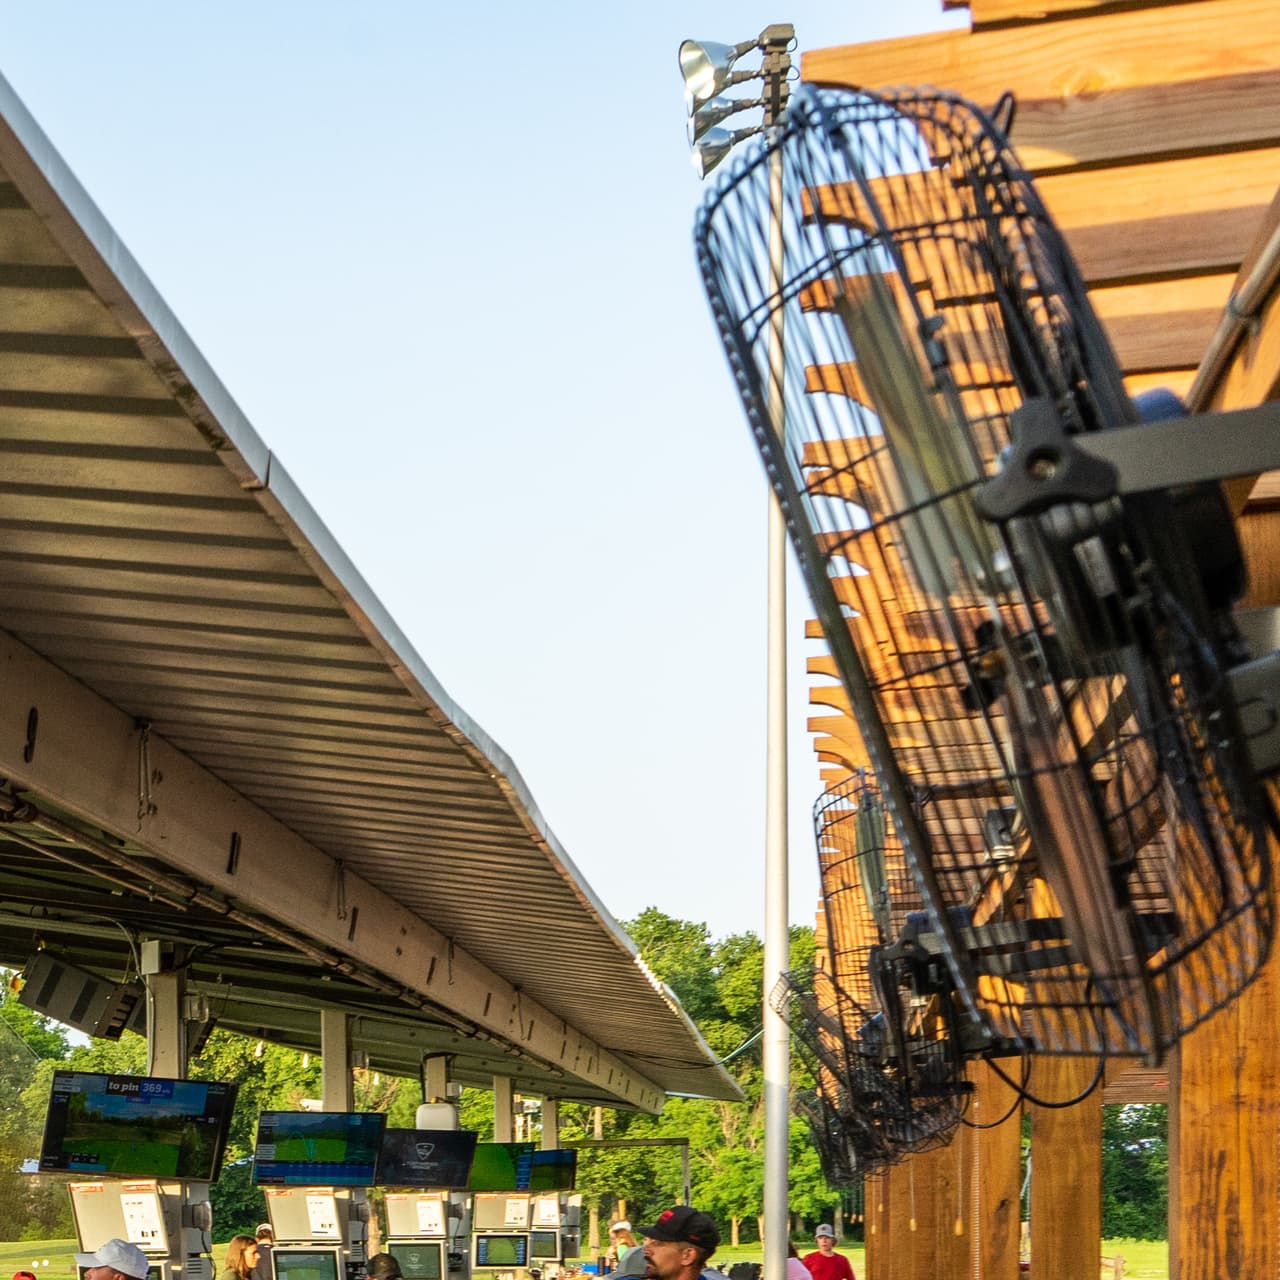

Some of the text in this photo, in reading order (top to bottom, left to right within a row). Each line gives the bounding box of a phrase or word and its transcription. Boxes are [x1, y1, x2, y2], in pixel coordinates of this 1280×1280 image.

[108, 1082, 139, 1092] to pin
[143, 1082, 163, 1093] 369
